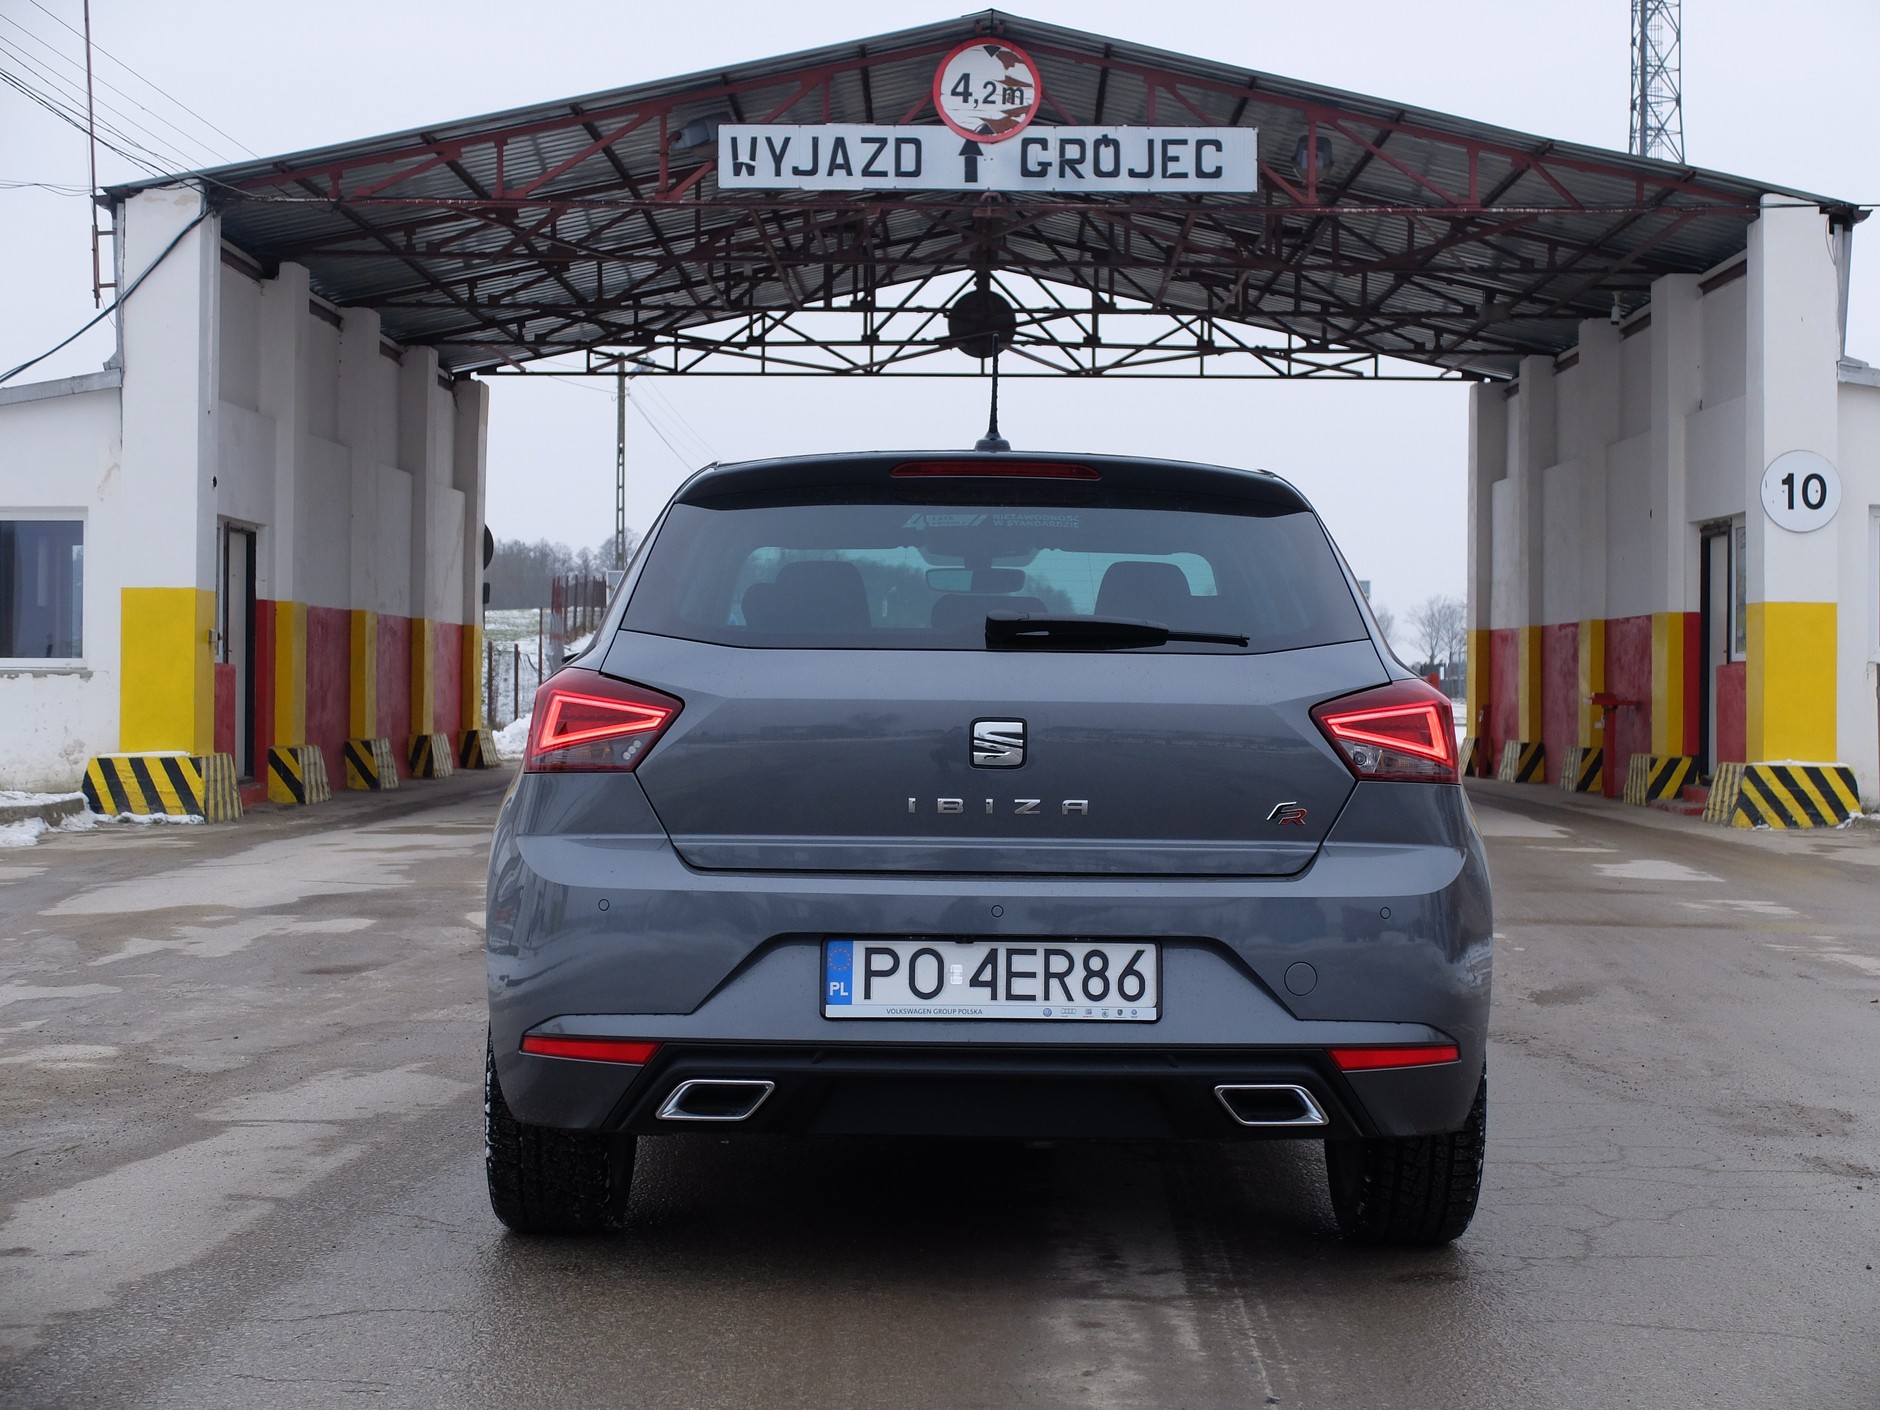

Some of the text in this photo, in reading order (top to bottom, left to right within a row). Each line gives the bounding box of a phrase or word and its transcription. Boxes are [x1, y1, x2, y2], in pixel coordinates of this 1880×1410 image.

[730, 136, 922, 178] WYJAZD
[1781, 472, 1827, 511] 10
[908, 797, 1089, 816] IBIZA
[1266, 801, 1307, 825] FR
[829, 981, 849, 996] PL
[863, 947, 1147, 1002] PO 4ER86
